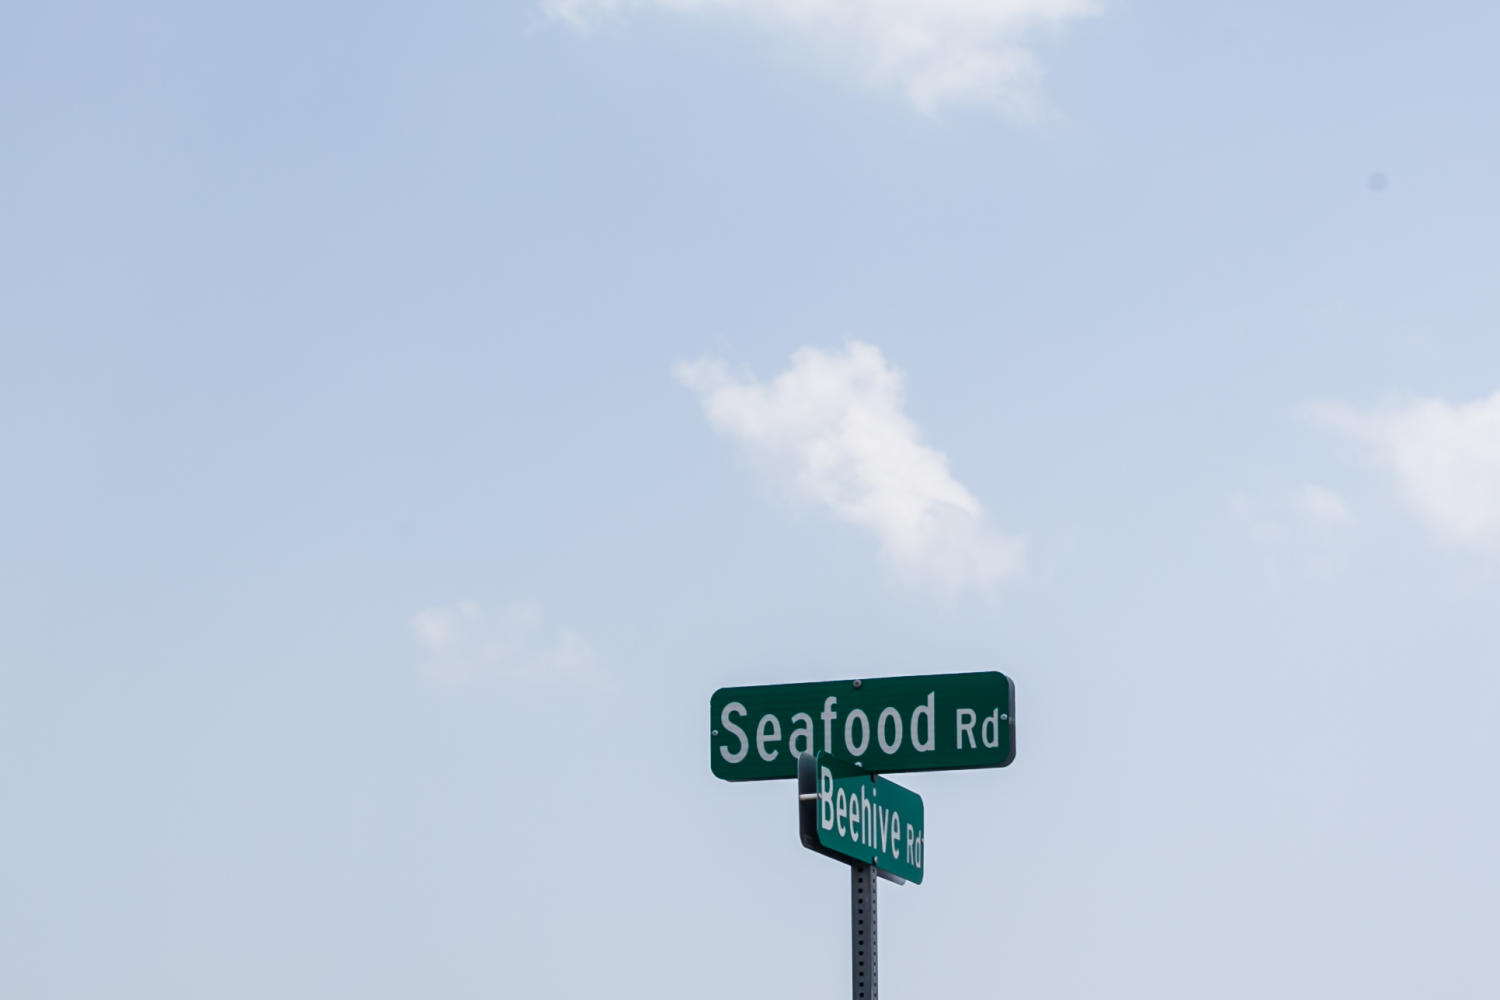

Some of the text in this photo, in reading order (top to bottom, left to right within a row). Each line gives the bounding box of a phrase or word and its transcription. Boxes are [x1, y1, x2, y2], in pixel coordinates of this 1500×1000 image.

[720, 691, 999, 764] Seafood Rd
[821, 765, 921, 868] Beehive Rd
